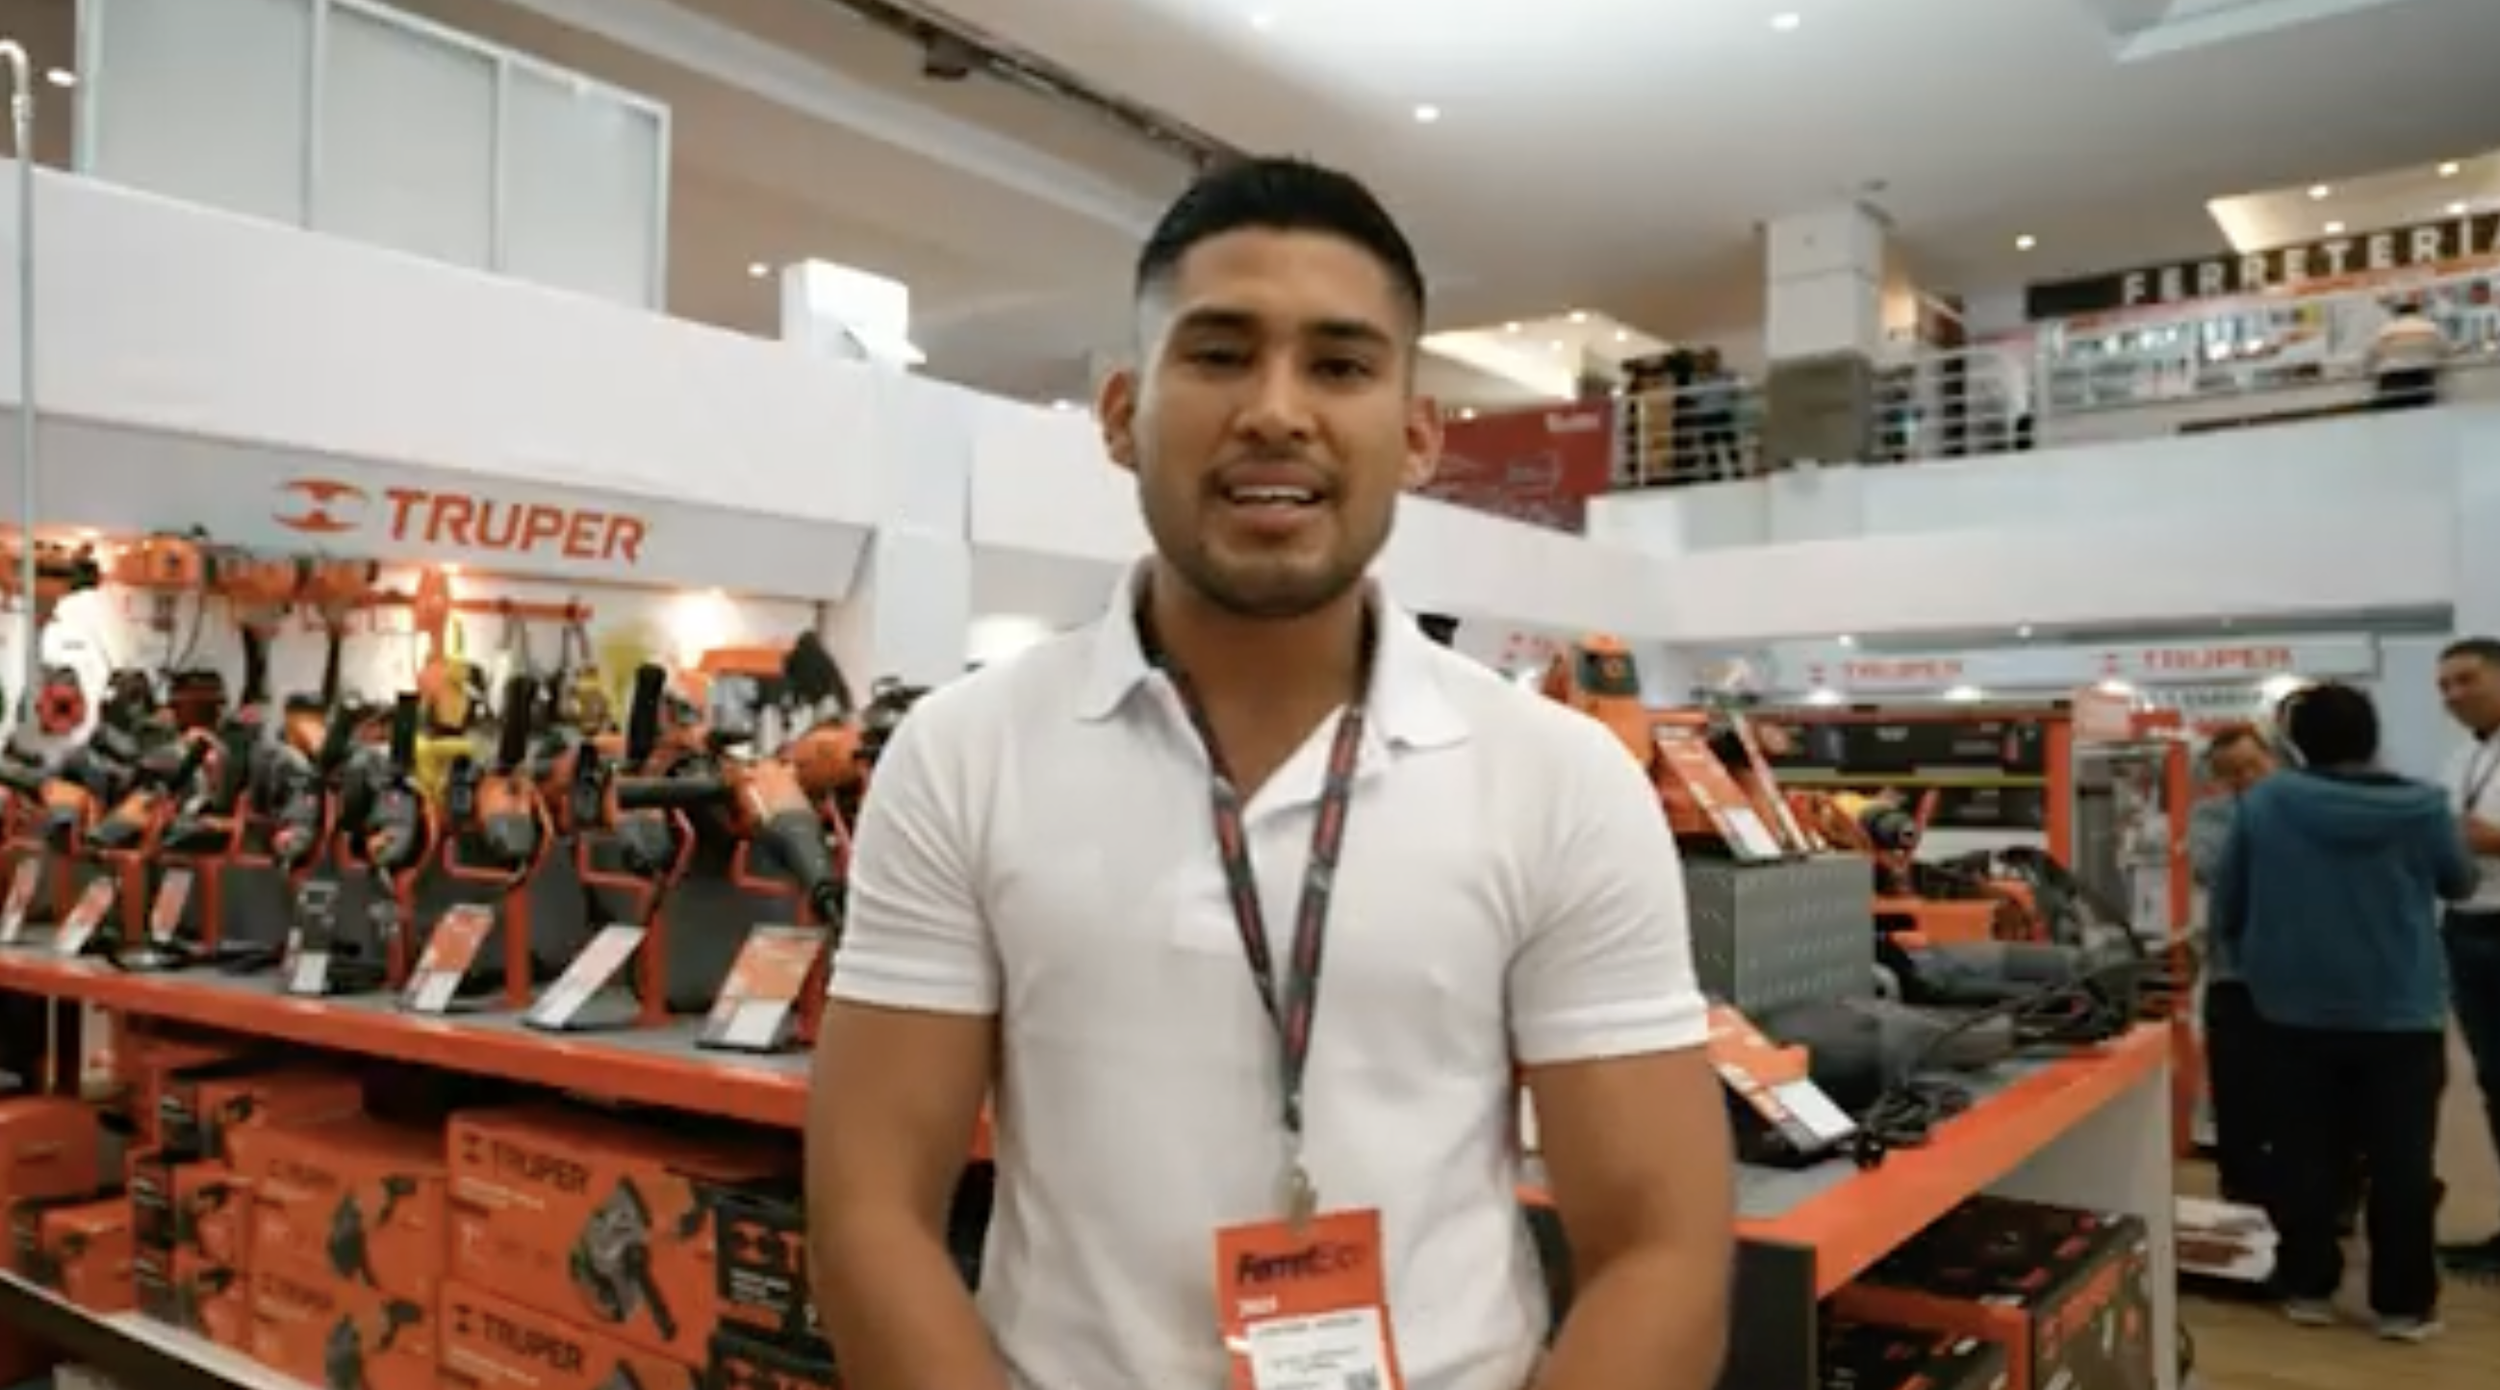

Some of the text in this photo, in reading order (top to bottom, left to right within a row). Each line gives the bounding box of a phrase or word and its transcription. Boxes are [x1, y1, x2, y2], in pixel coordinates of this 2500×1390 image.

[384, 486, 646, 565] TRUPER
[488, 1138, 592, 1196] TRUPER
[482, 1309, 587, 1378] TRUPER
